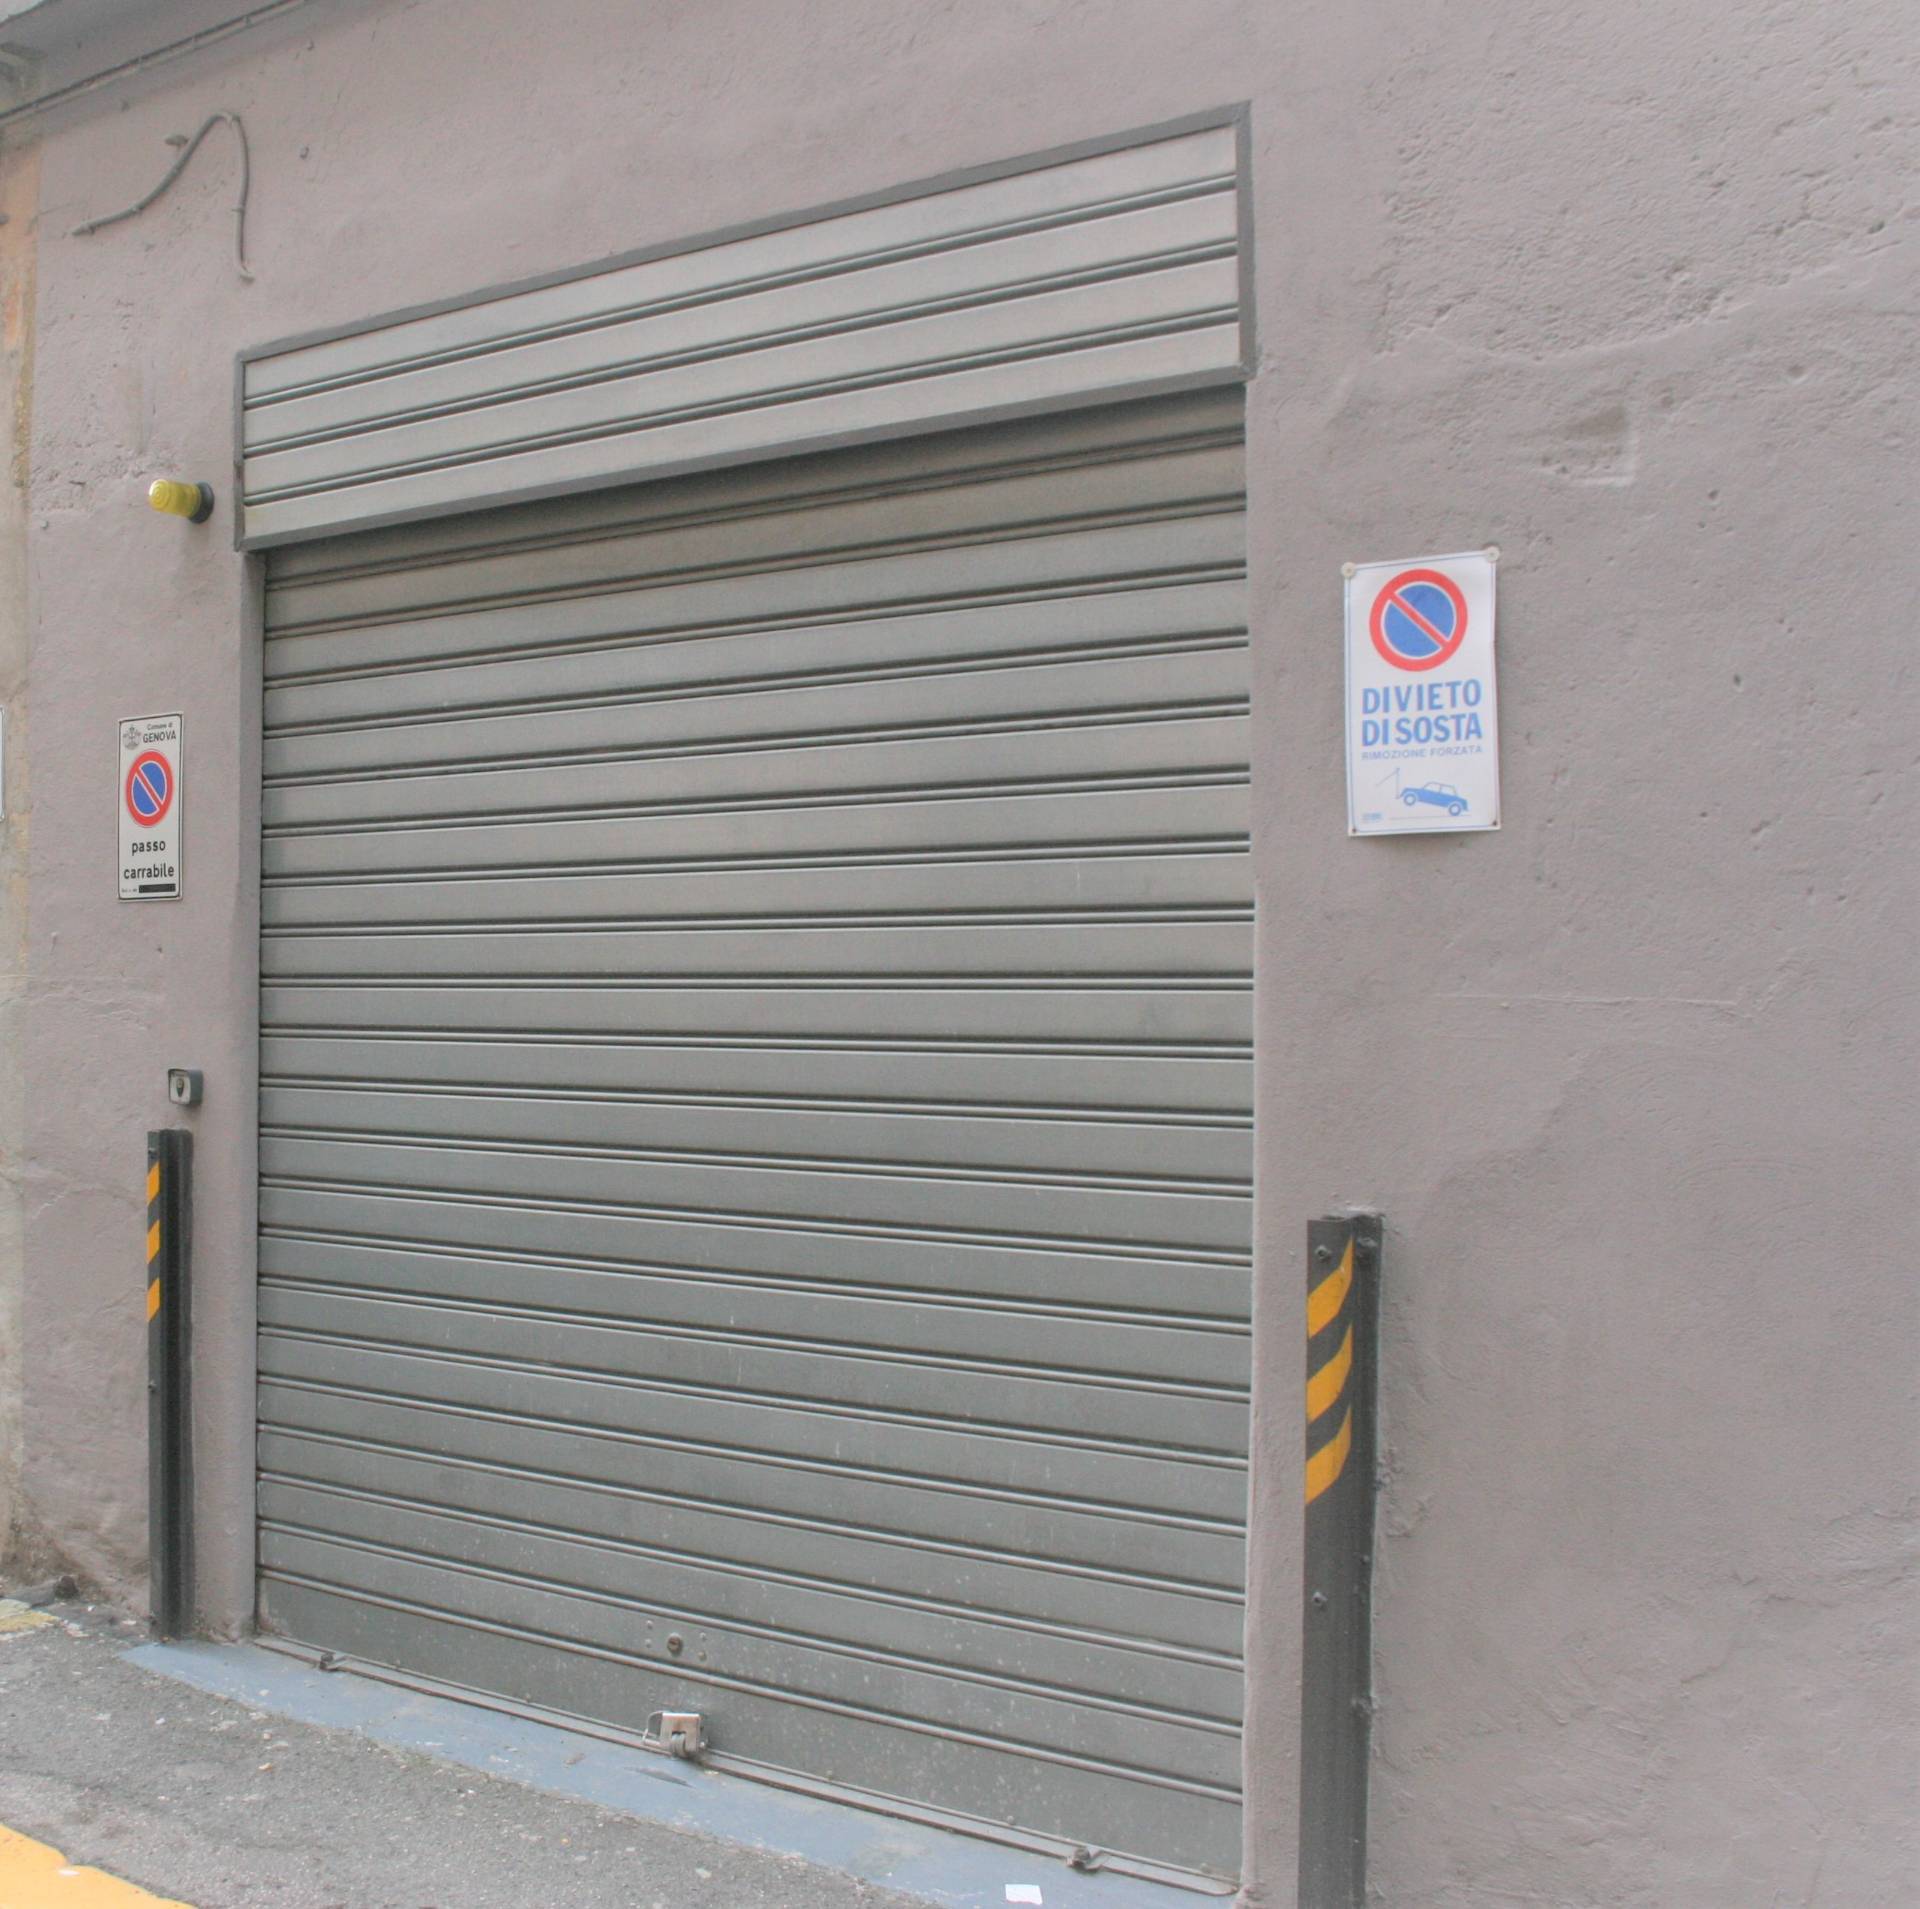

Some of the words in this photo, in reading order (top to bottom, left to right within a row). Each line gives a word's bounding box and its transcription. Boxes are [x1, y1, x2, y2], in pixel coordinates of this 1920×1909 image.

[1362, 679, 1481, 714] DIVIETO
[143, 730, 176, 743] GENOVA
[1362, 719, 1389, 746] DI
[1395, 712, 1482, 745] SOSTA
[1361, 749, 1427, 760] RIMOZIONE
[1430, 745, 1483, 757] FORZATA
[132, 841, 166, 856] passo
[124, 863, 174, 879] carrabile
